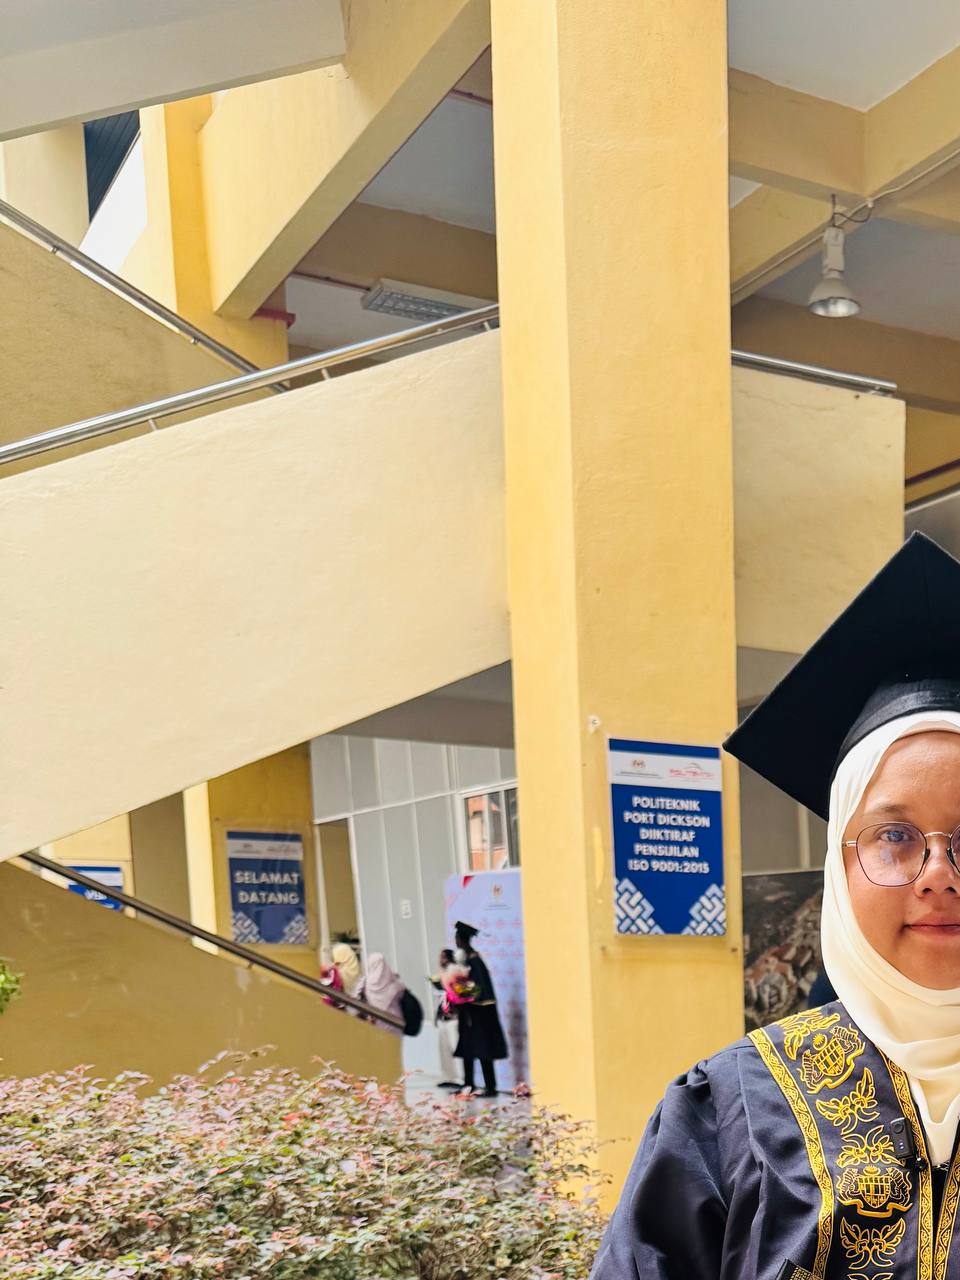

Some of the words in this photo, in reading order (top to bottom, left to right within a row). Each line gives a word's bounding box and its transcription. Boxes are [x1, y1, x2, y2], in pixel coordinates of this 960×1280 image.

[633, 796, 700, 811] POLITEKNIK
[624, 812, 654, 824] PORT
[657, 813, 710, 827] DICKSON
[640, 829, 695, 842] DIIKTIRAF
[628, 859, 649, 871] ISO
[651, 860, 709, 873] 9001:2015
[235, 870, 299, 884] SELAMAT
[239, 890, 299, 904] DATANG
